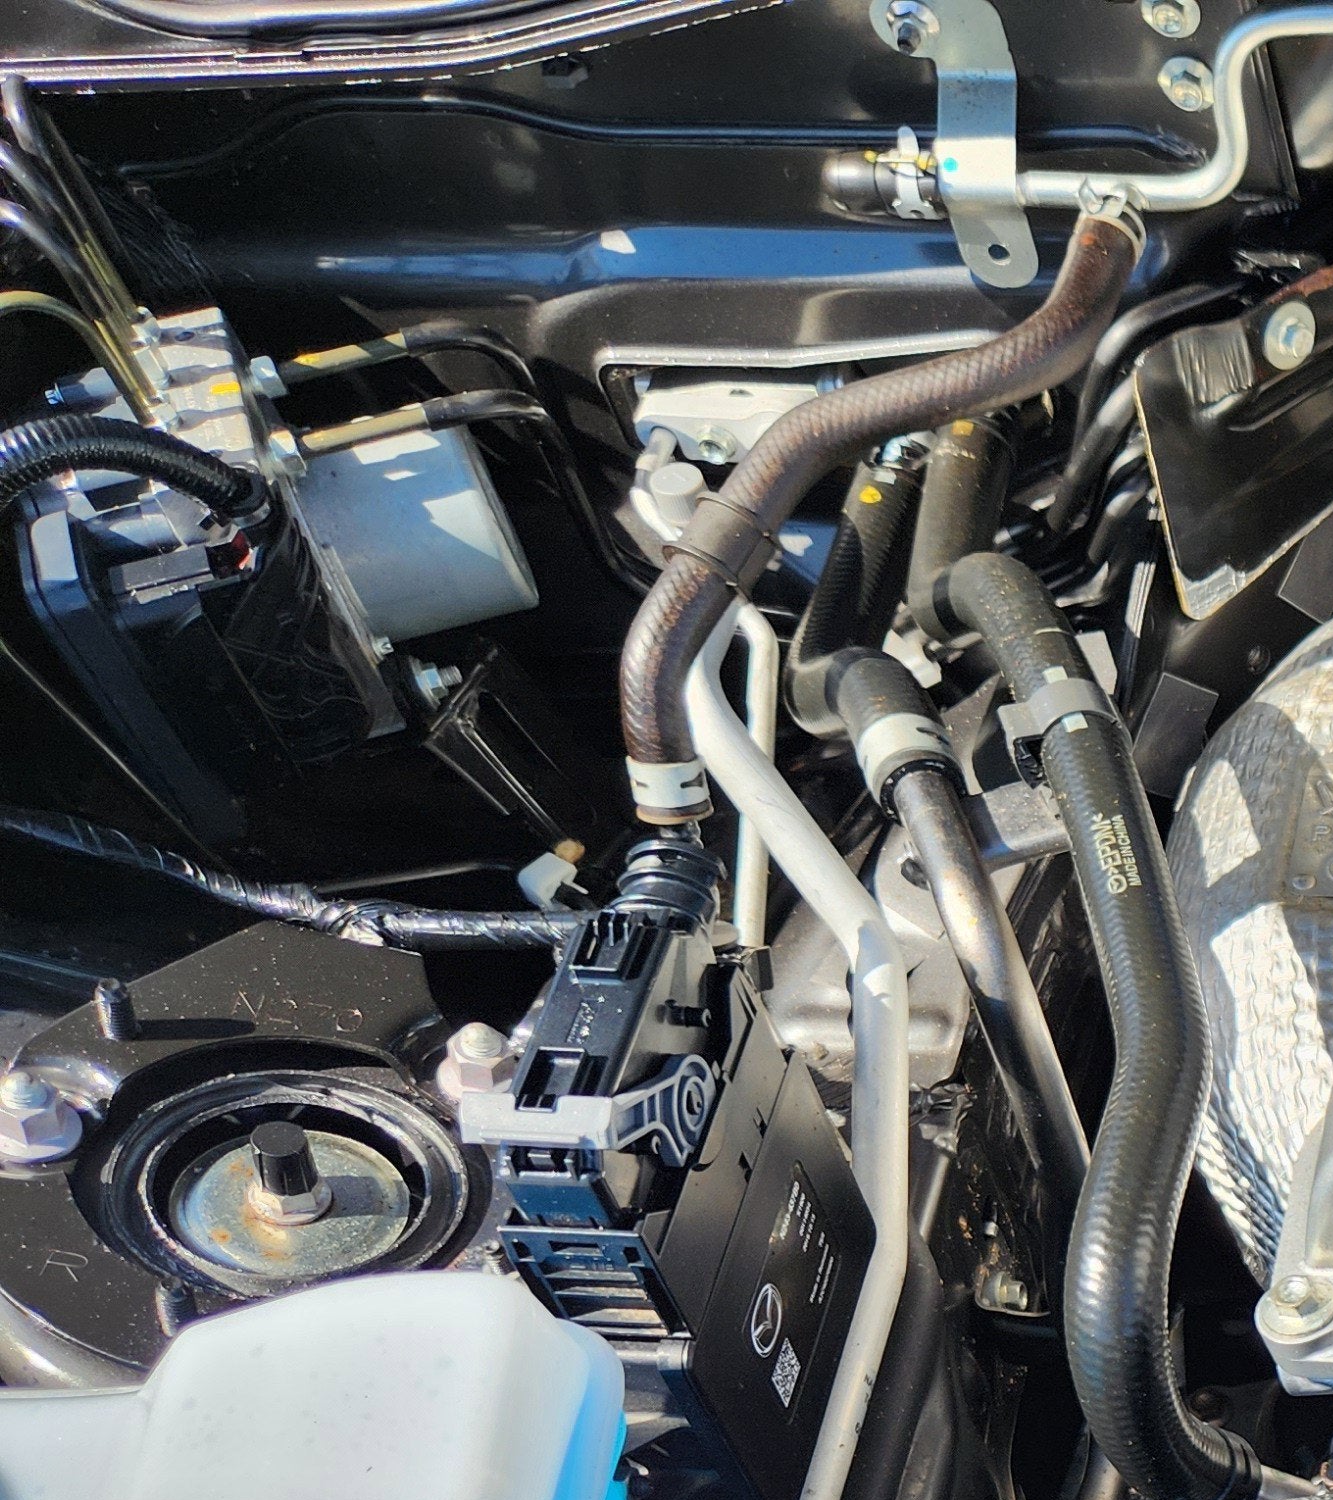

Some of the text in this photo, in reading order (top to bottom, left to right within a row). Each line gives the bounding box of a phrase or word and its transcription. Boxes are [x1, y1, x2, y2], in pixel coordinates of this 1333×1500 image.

[1111, 814, 1143, 886] MADE IN CHINA
[39, 1249, 89, 1283] R
